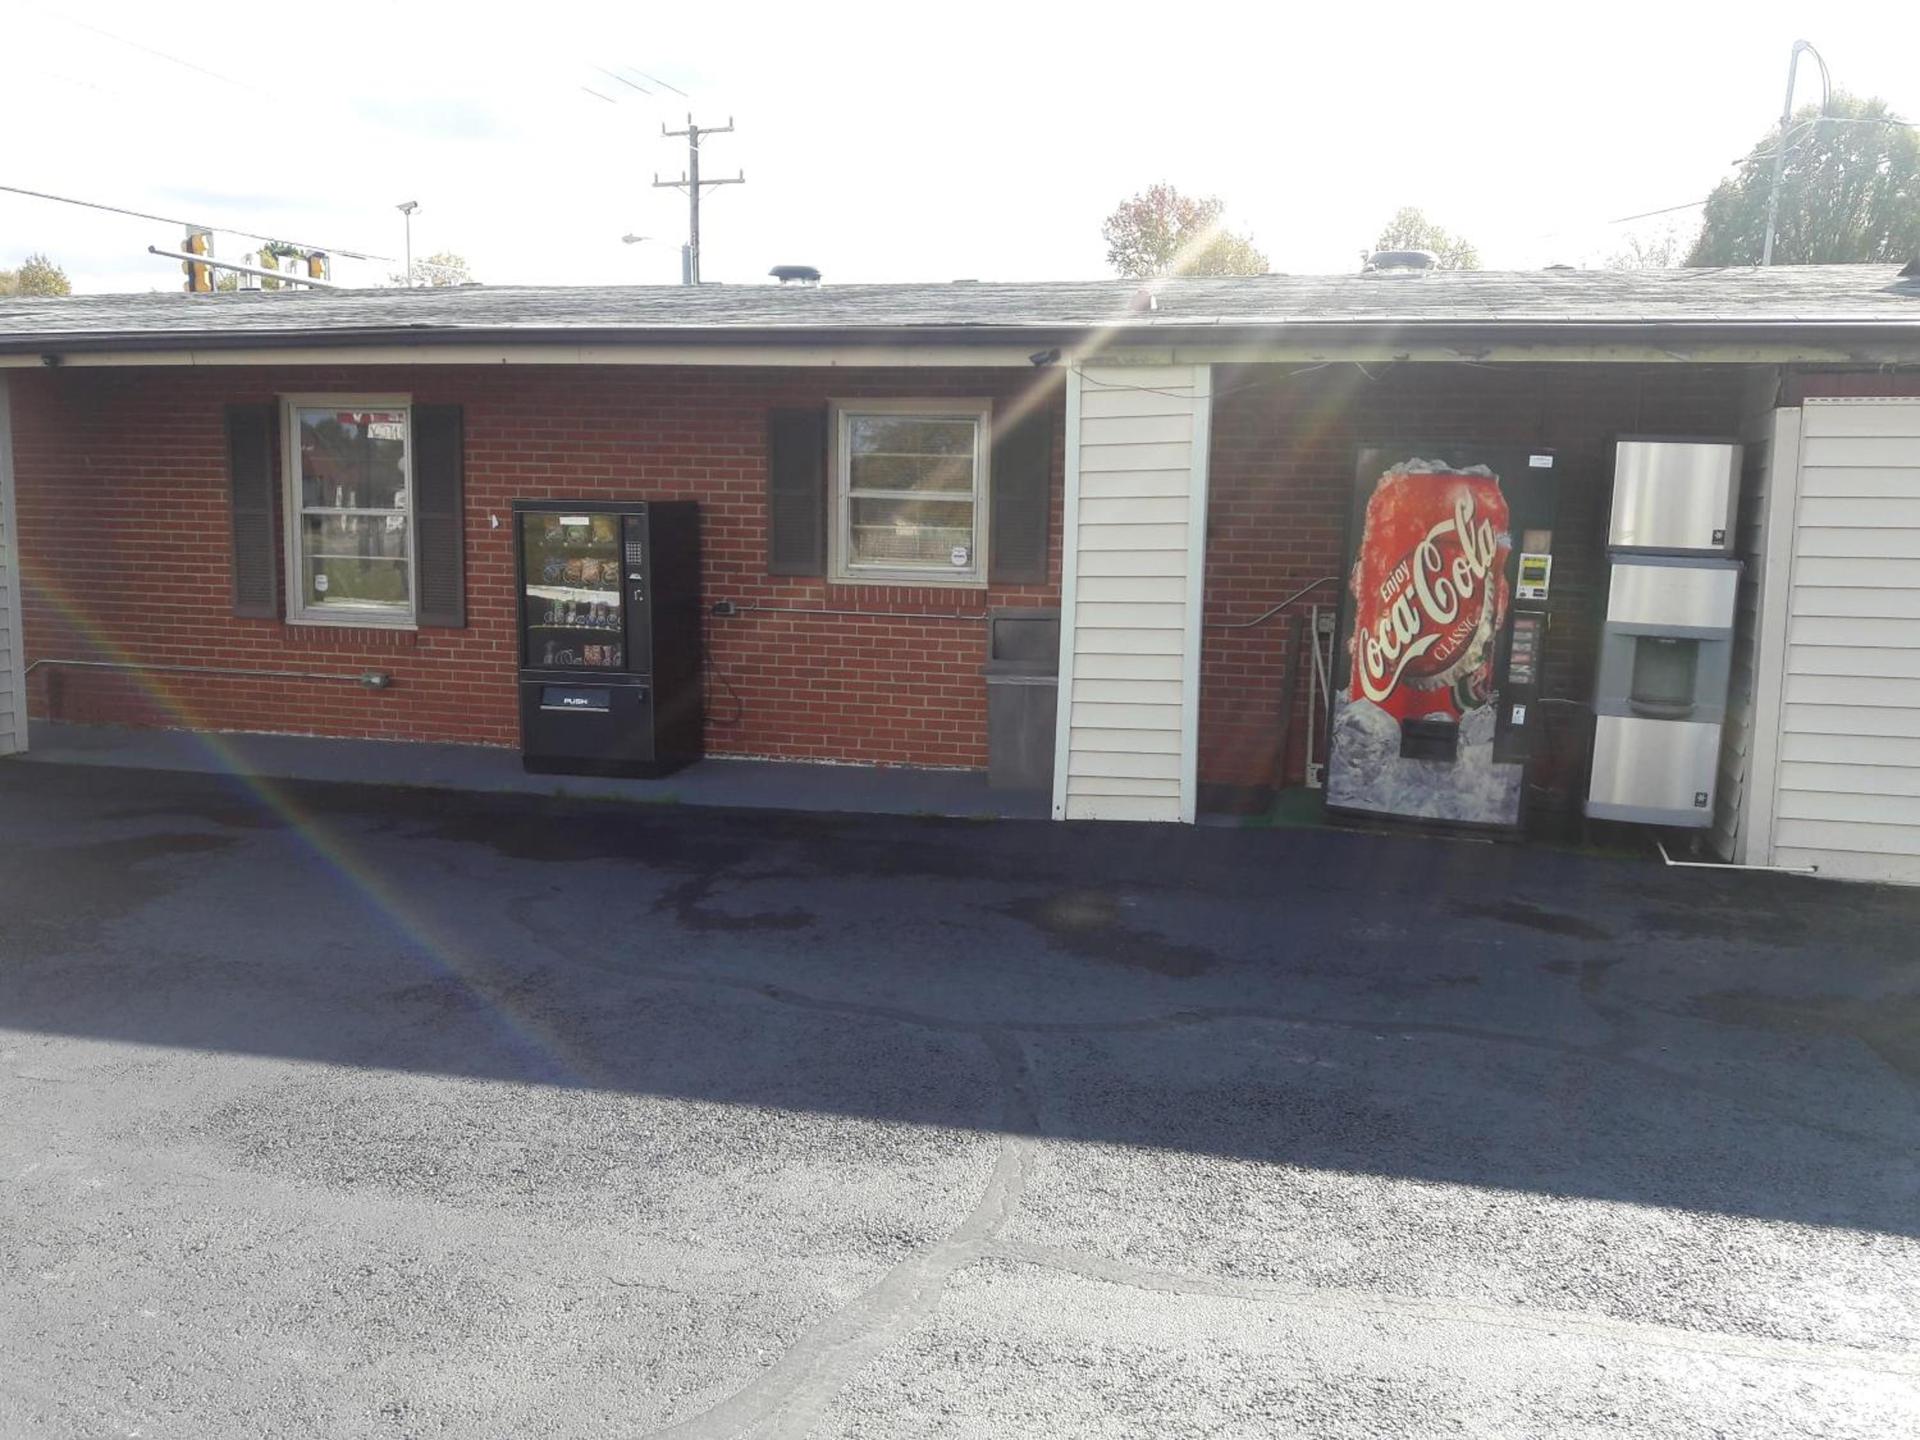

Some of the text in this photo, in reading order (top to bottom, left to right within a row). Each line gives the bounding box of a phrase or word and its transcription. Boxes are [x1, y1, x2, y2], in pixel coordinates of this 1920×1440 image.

[1359, 487, 1497, 702] Coca-Cola
[1380, 560, 1410, 603] Enjoy
[1433, 614, 1481, 662] CLASSIC
